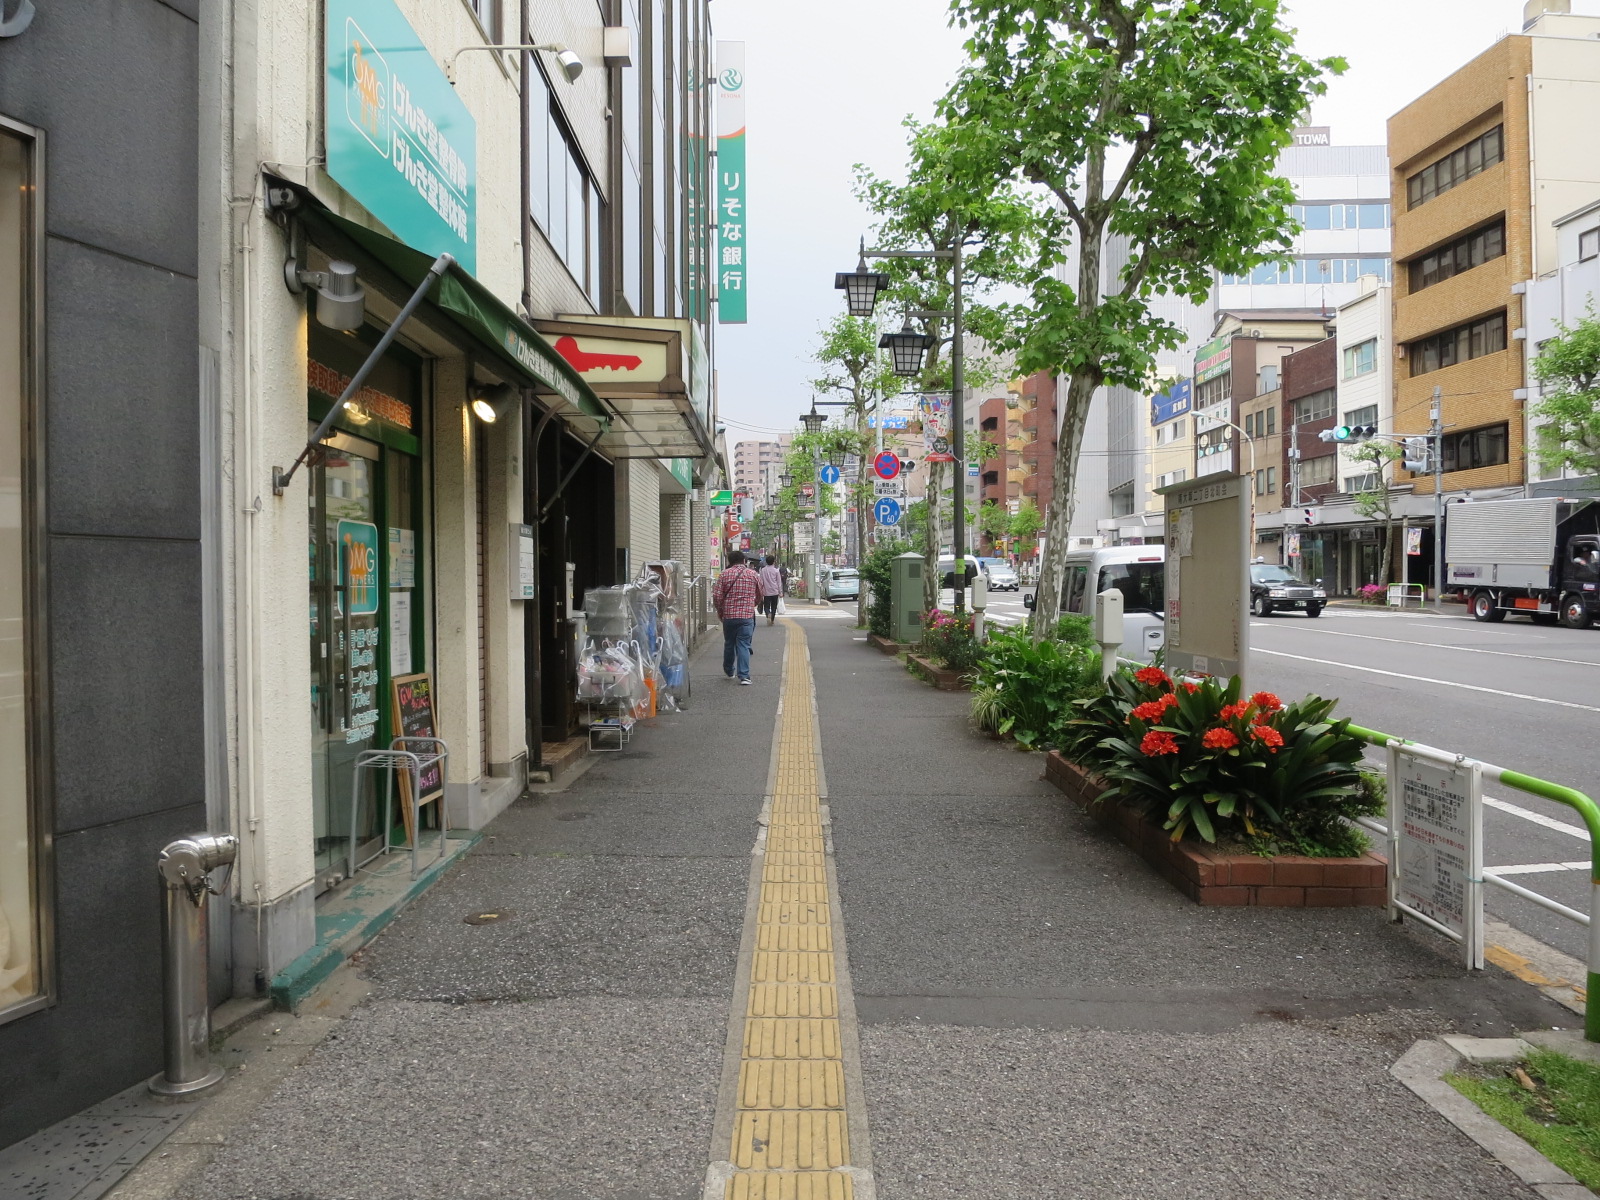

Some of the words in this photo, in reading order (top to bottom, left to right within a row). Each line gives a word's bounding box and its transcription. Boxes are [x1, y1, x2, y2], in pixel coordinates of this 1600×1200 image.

[1295, 133, 1328, 145] TOWA
[722, 172, 742, 290] りそな銀行
[880, 505, 891, 522] P
[886, 515, 895, 523] 60
